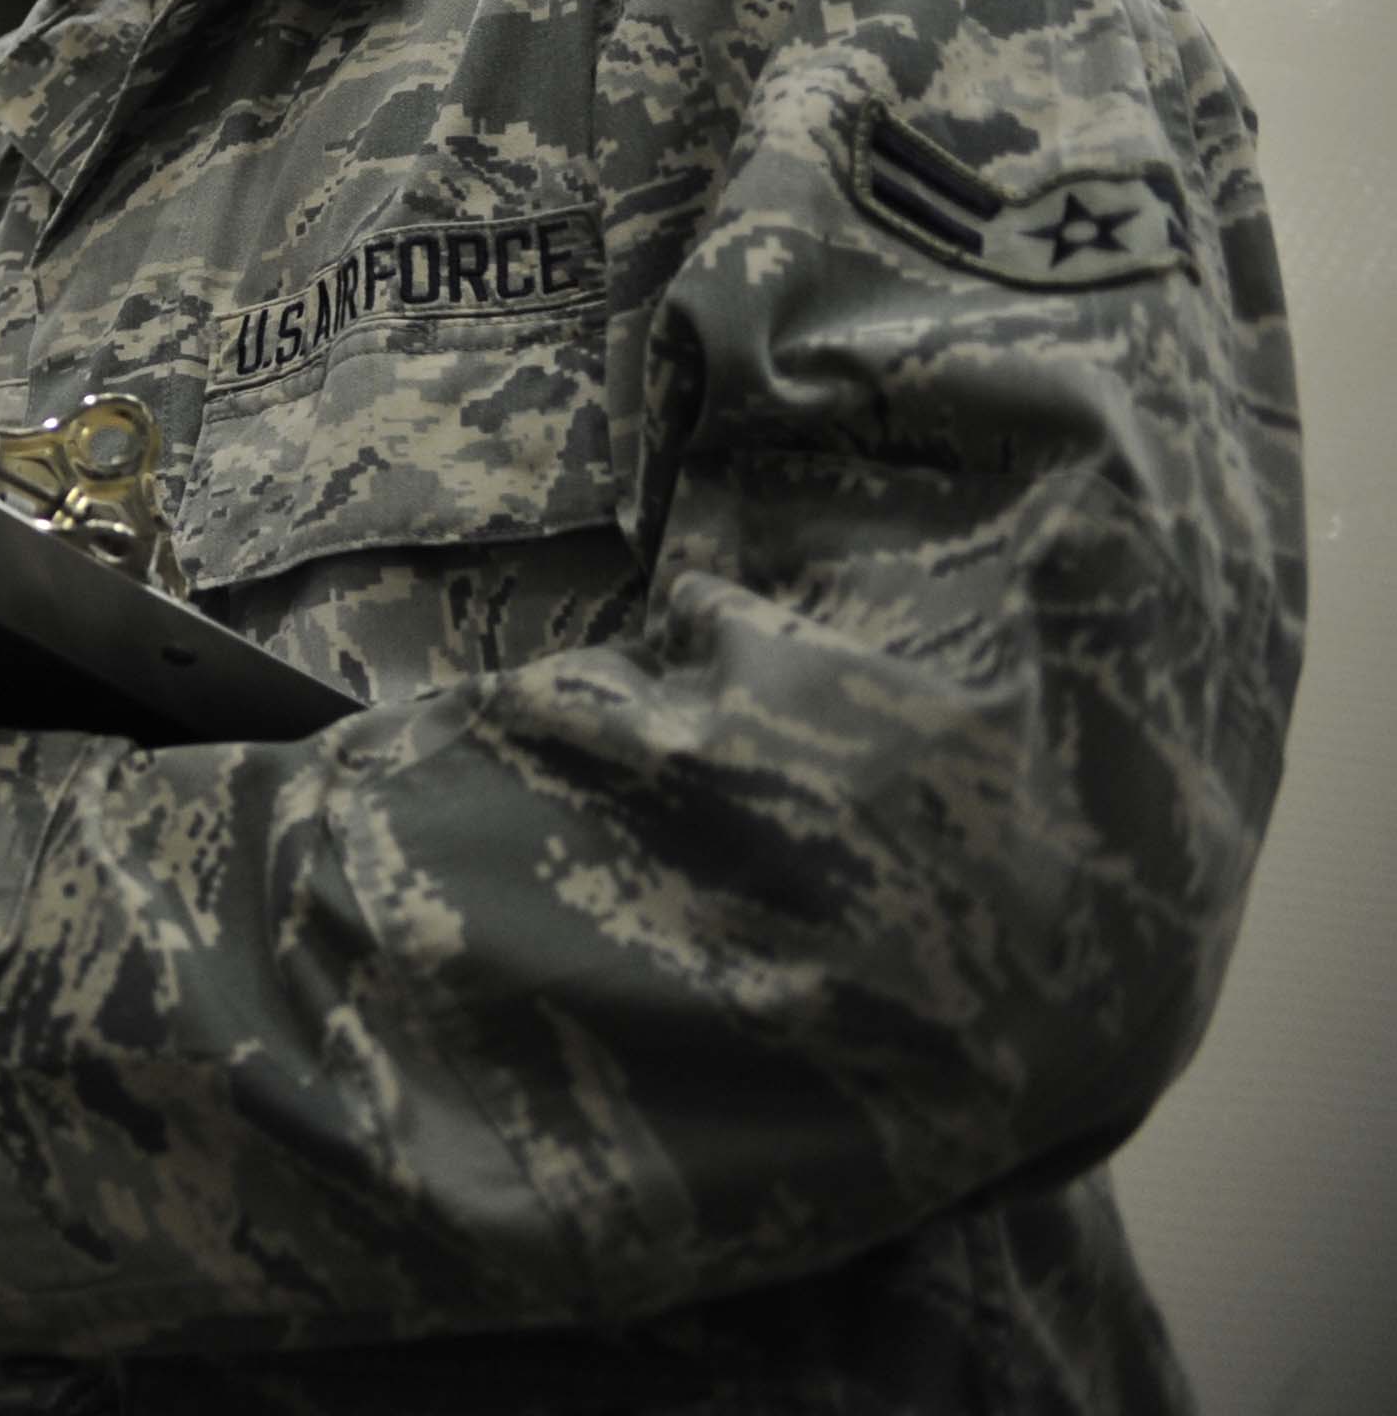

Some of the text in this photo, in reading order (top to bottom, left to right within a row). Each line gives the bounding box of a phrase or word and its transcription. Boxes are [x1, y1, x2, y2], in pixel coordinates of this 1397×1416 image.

[236, 220, 580, 376] U.S. AIR FORCE
